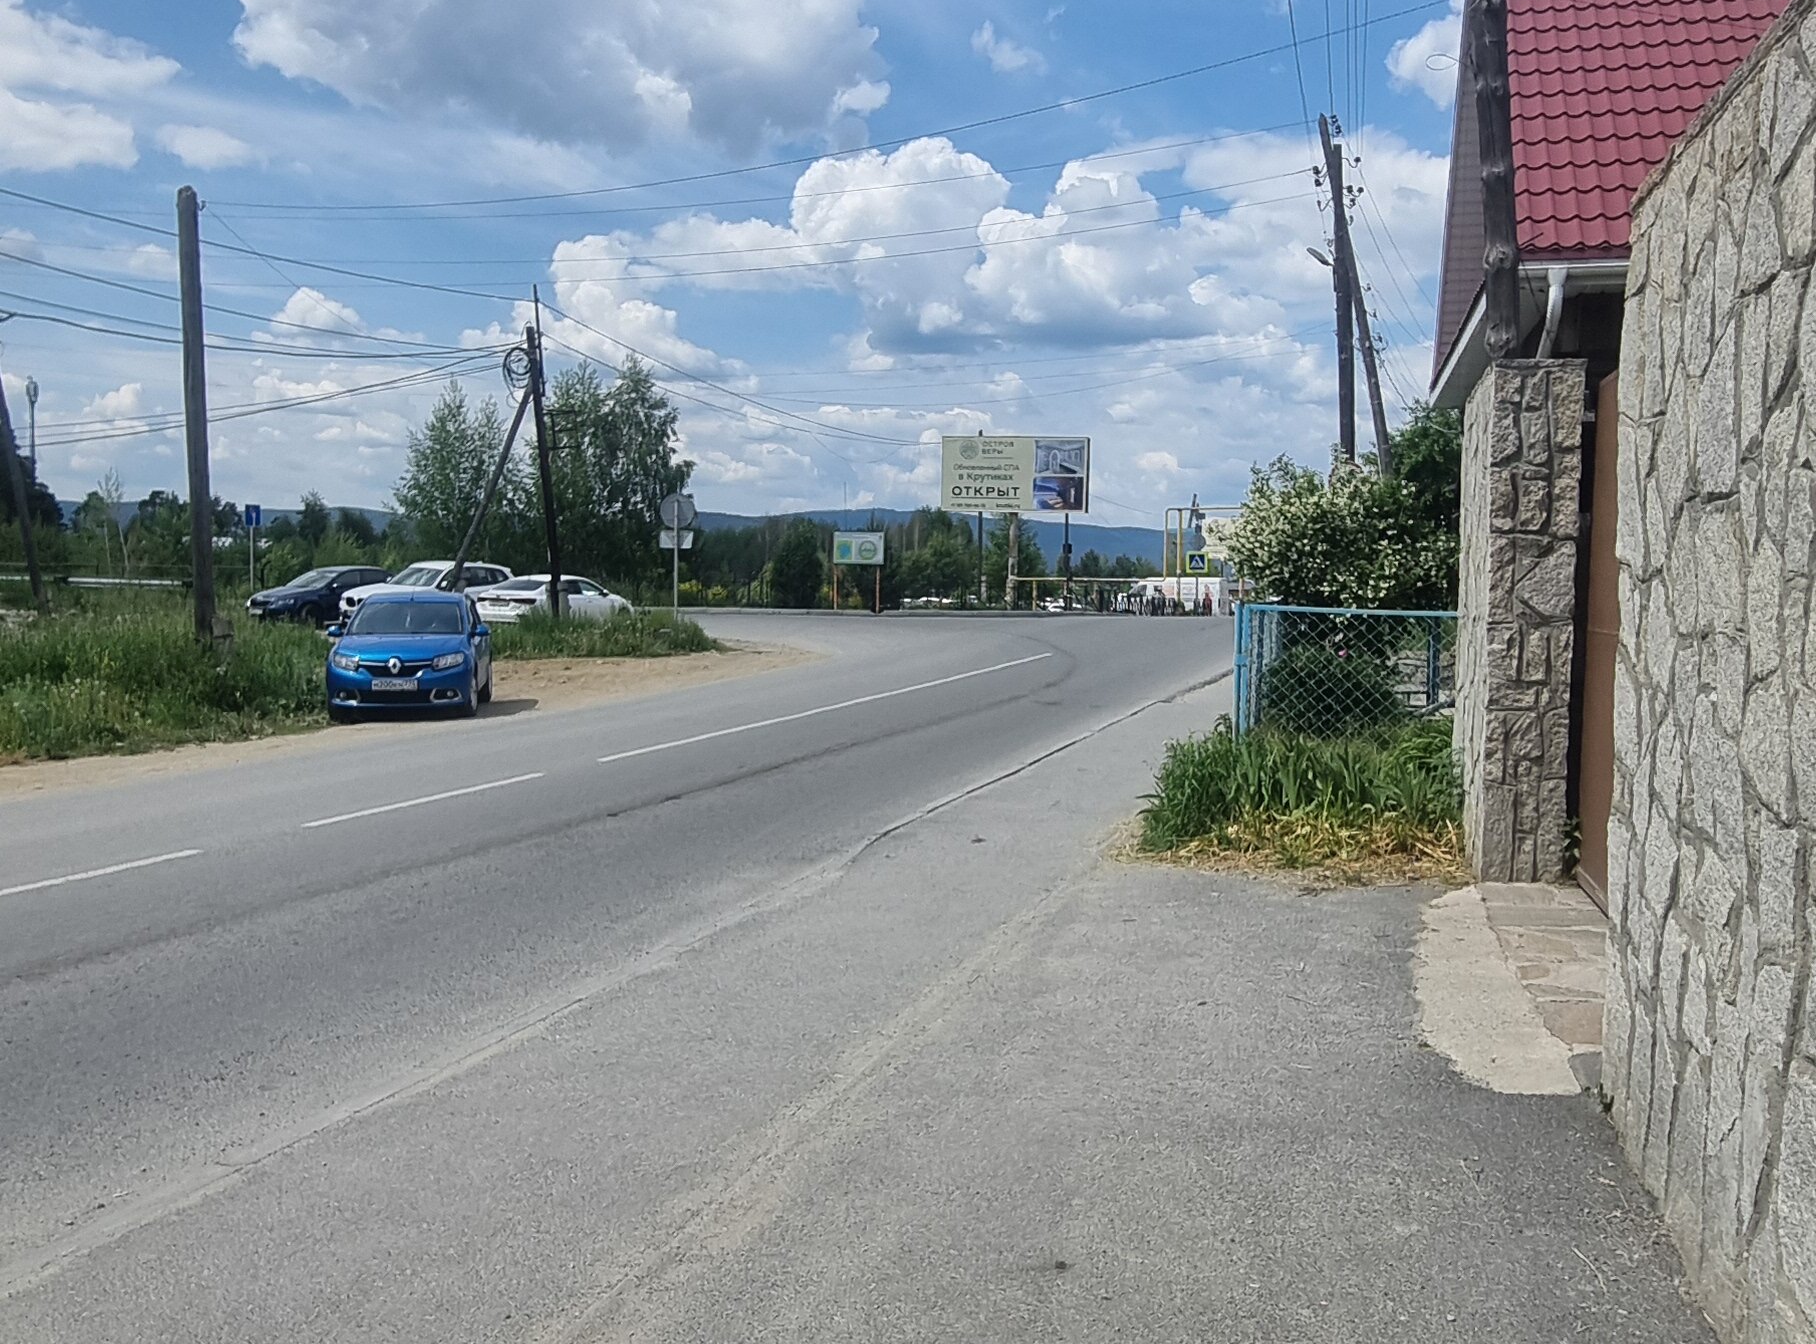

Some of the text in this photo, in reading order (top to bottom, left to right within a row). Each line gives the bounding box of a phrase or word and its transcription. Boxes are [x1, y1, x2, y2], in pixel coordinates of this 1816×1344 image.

[982, 440, 1015, 448] ОСТРОВ
[966, 472, 1014, 483] Крутиках
[951, 485, 1020, 497] ОТКРЫТ
